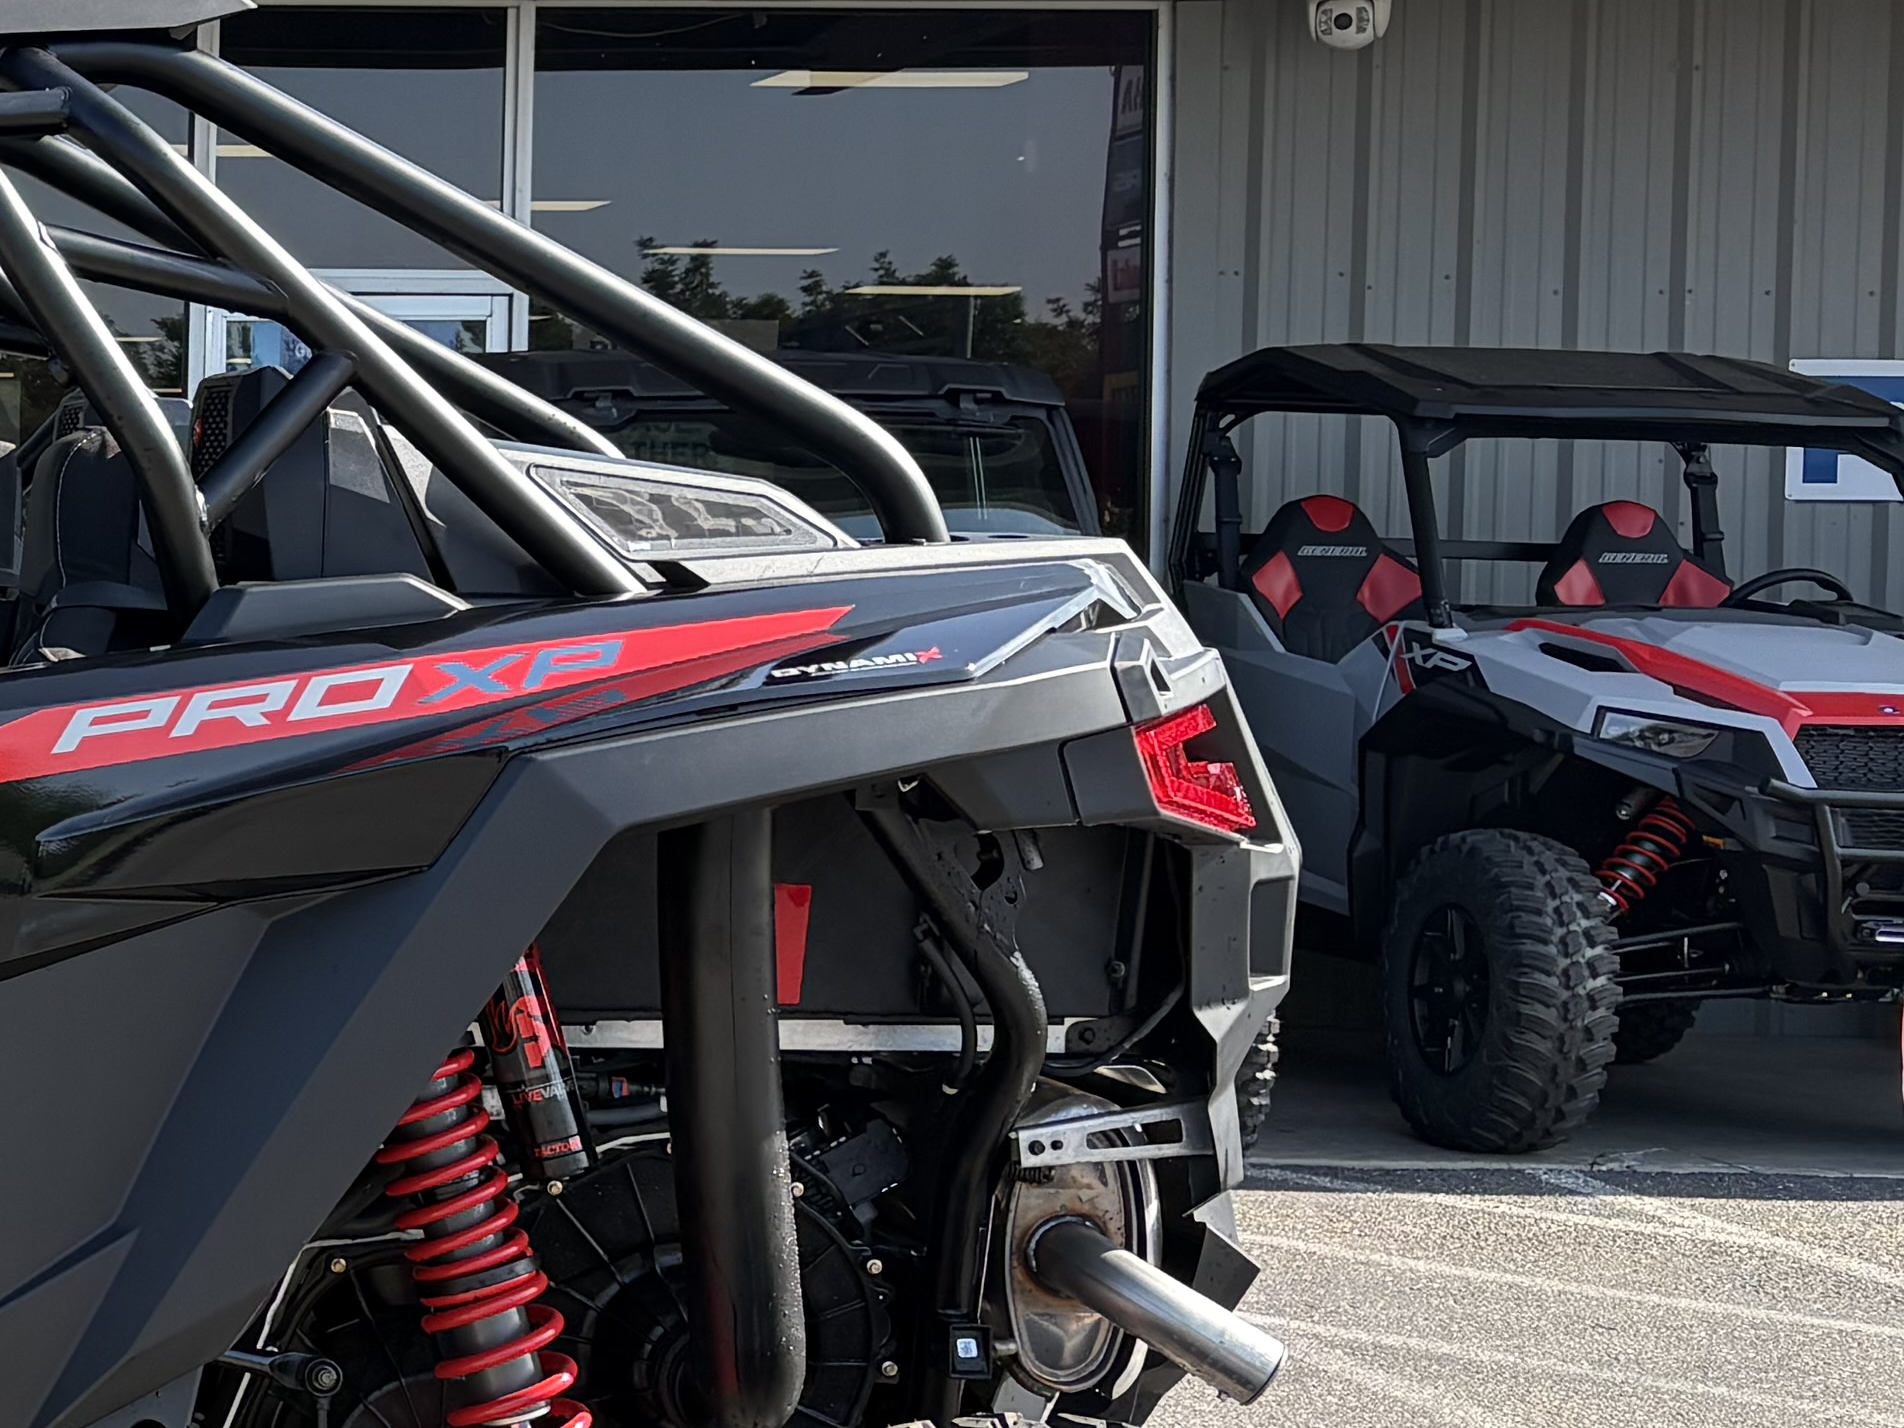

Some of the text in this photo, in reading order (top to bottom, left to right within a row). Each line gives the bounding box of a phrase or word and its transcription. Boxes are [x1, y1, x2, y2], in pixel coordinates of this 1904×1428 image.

[770, 646, 944, 679] DYNAMIX
[1398, 641, 1473, 673] XP
[50, 640, 625, 754] PRO XP
